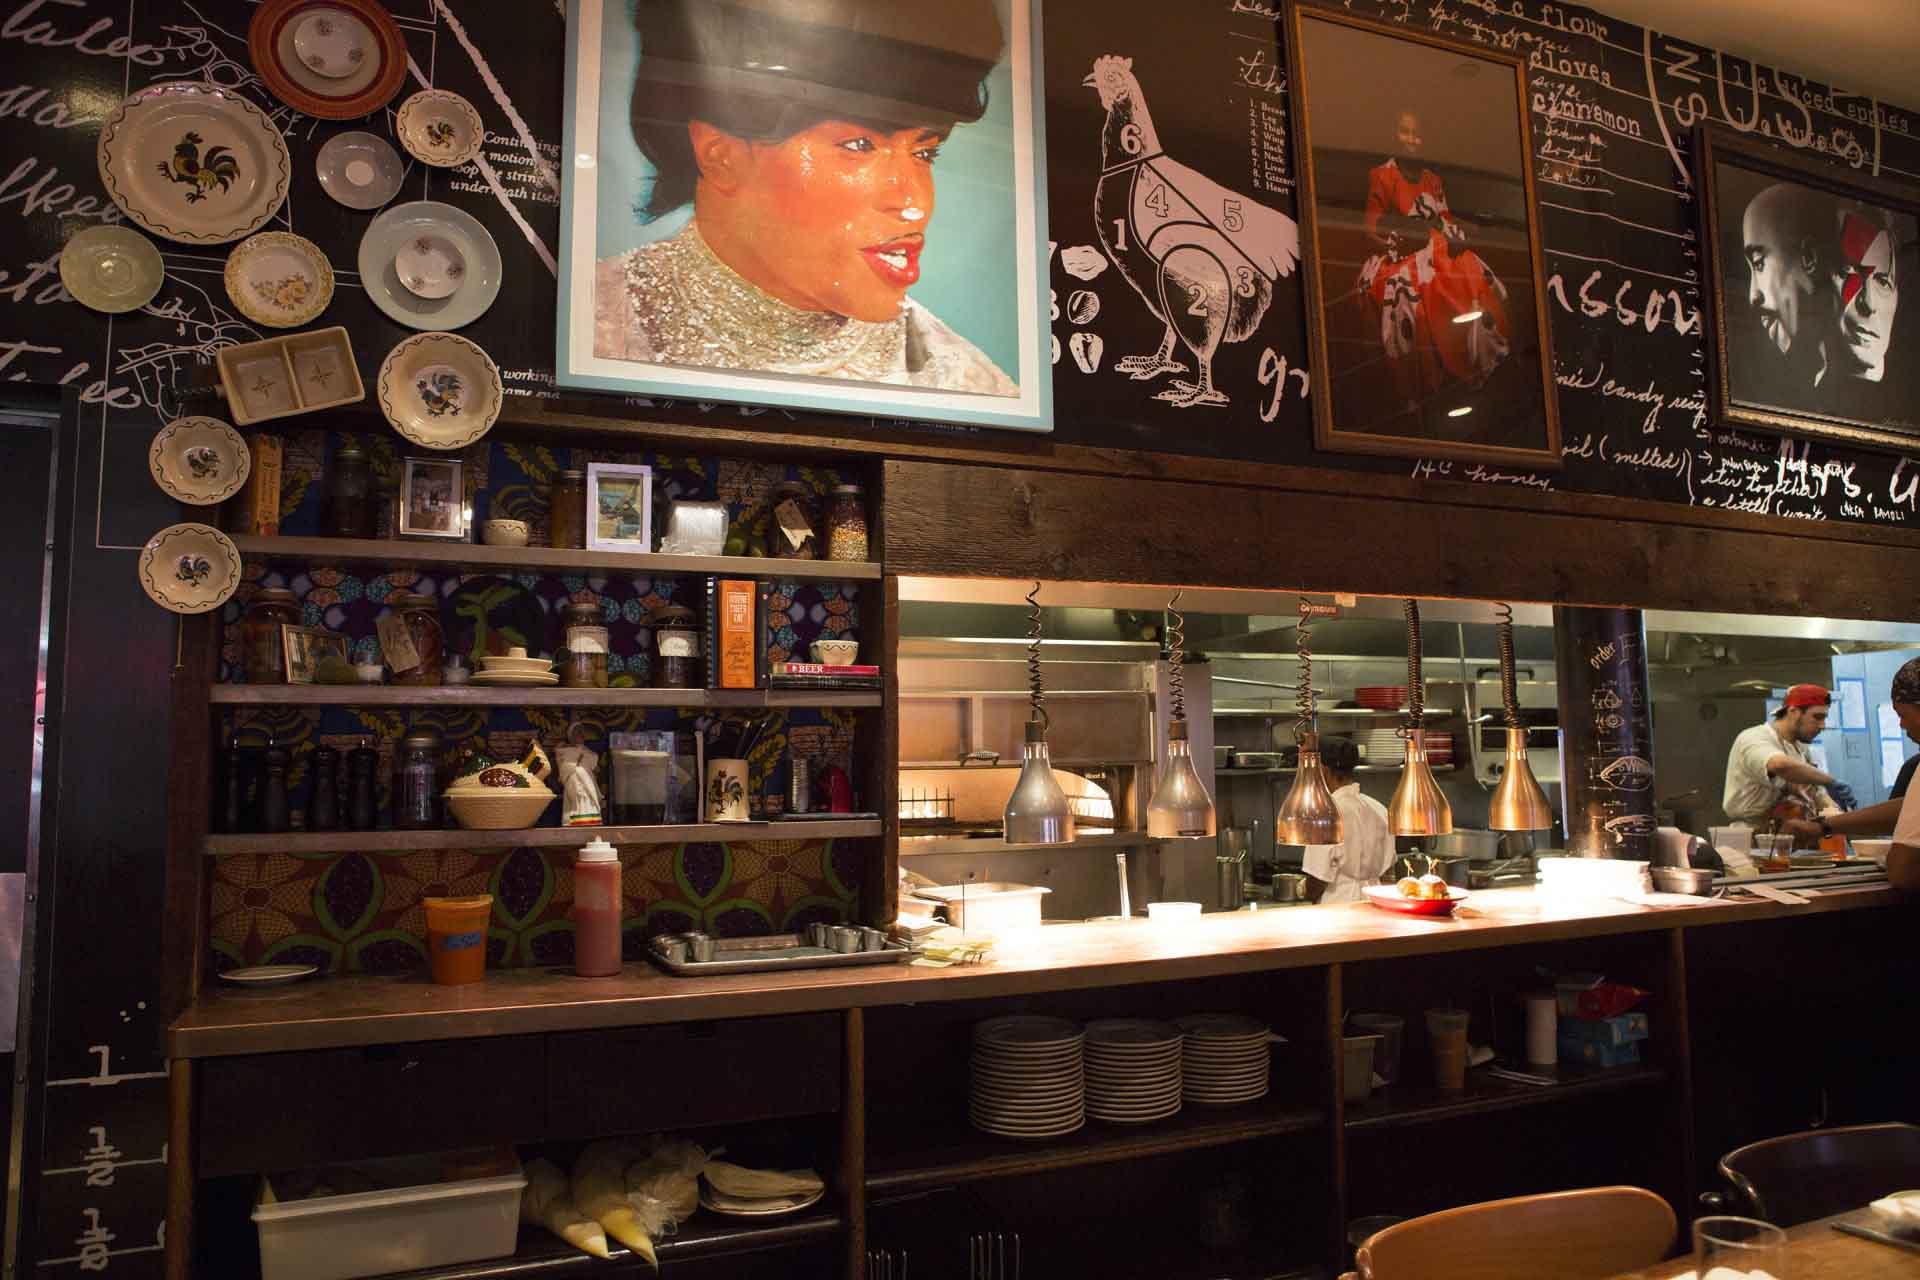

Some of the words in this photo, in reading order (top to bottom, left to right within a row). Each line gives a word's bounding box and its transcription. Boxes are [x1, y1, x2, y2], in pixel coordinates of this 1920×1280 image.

[1541, 5, 1608, 40] flour
[1529, 50, 1612, 86] cloves
[1263, 122, 1286, 136] Thigh
[1532, 93, 1642, 137] cinnamon
[484, 131, 560, 157] Contiing
[1120, 123, 1142, 155] 6
[1263, 131, 1285, 146] Wing
[1264, 151, 1285, 164] Neck
[1264, 160, 1286, 174] Liver
[451, 162, 479, 178] oop
[506, 169, 544, 188] string
[1266, 181, 1289, 195] Heart
[1144, 184, 1169, 217] 4
[1222, 199, 1244, 232] 5
[1112, 218, 1128, 251] 1
[1237, 265, 1257, 299] 3
[1187, 283, 1209, 317] 2
[503, 368, 557, 386] working
[1602, 380, 1665, 434] candy
[798, 665, 824, 673] BEER
[1589, 640, 1617, 670] order
